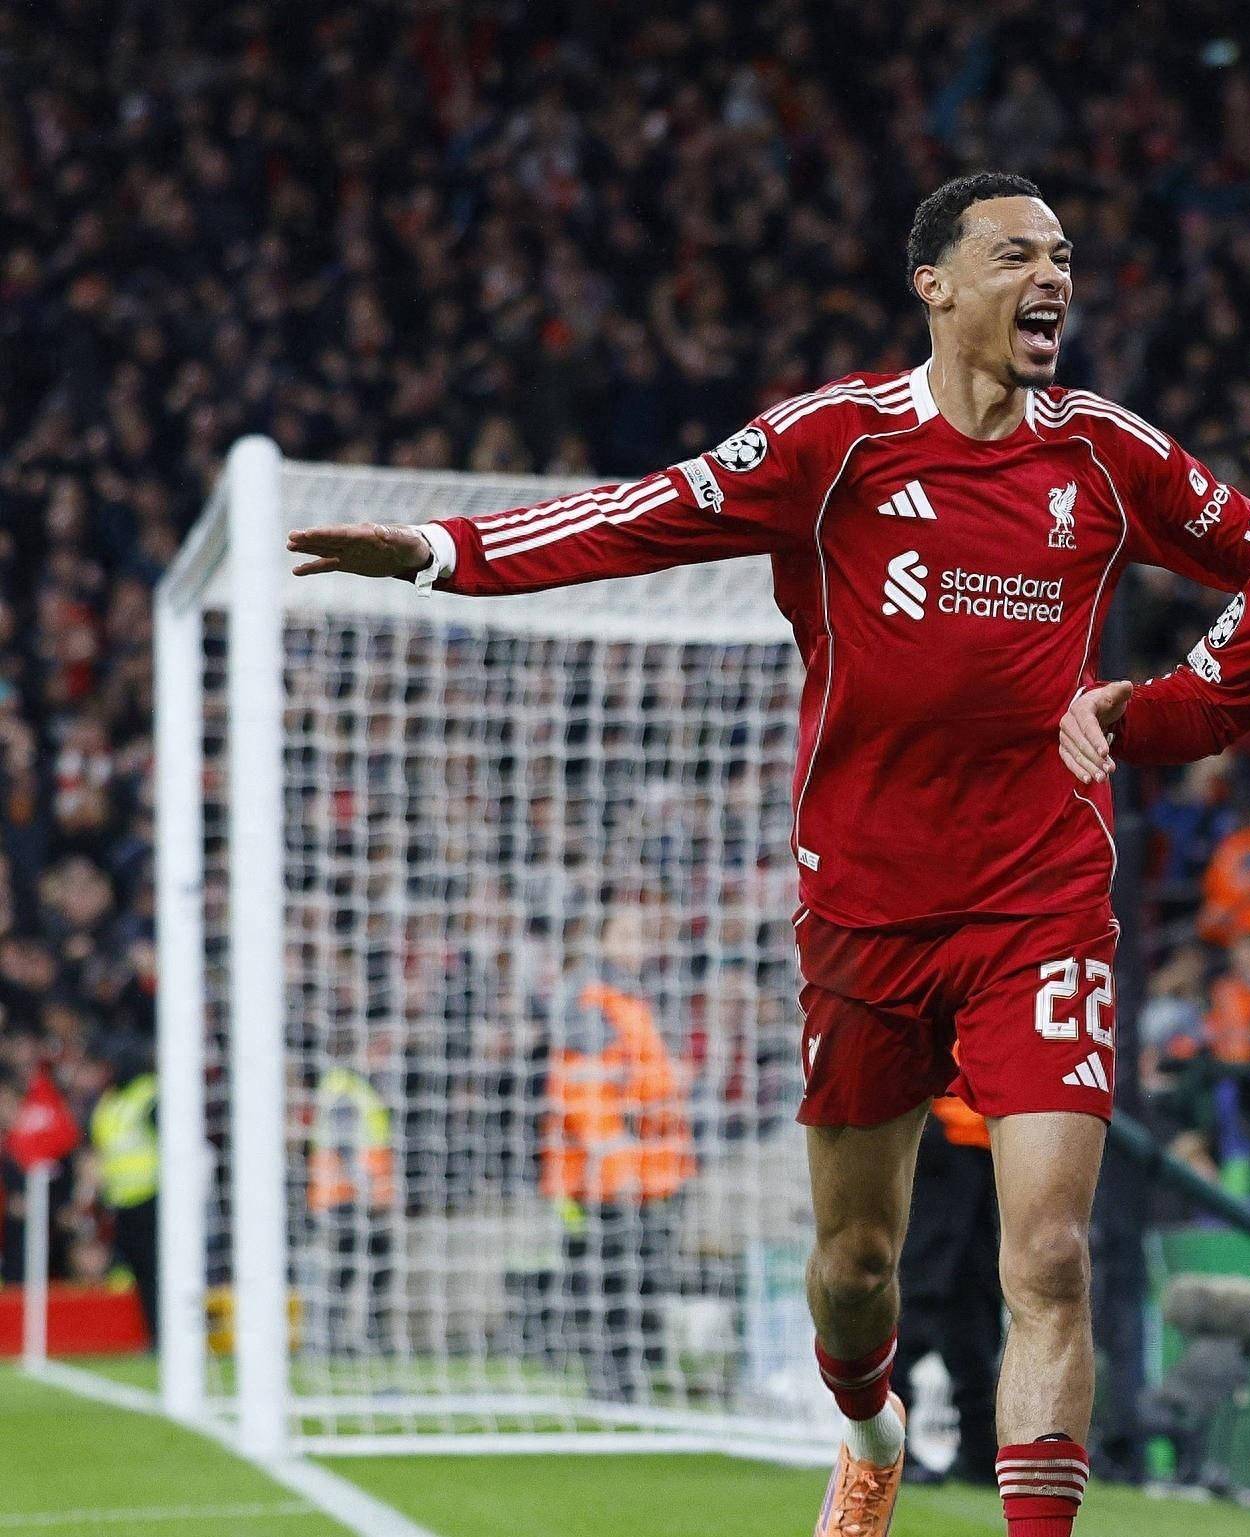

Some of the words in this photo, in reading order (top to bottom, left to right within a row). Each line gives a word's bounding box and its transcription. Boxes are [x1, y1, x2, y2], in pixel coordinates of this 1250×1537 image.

[940, 567, 1064, 600] standard
[938, 590, 1064, 623] chartered
[1035, 956, 1115, 1051] 22
